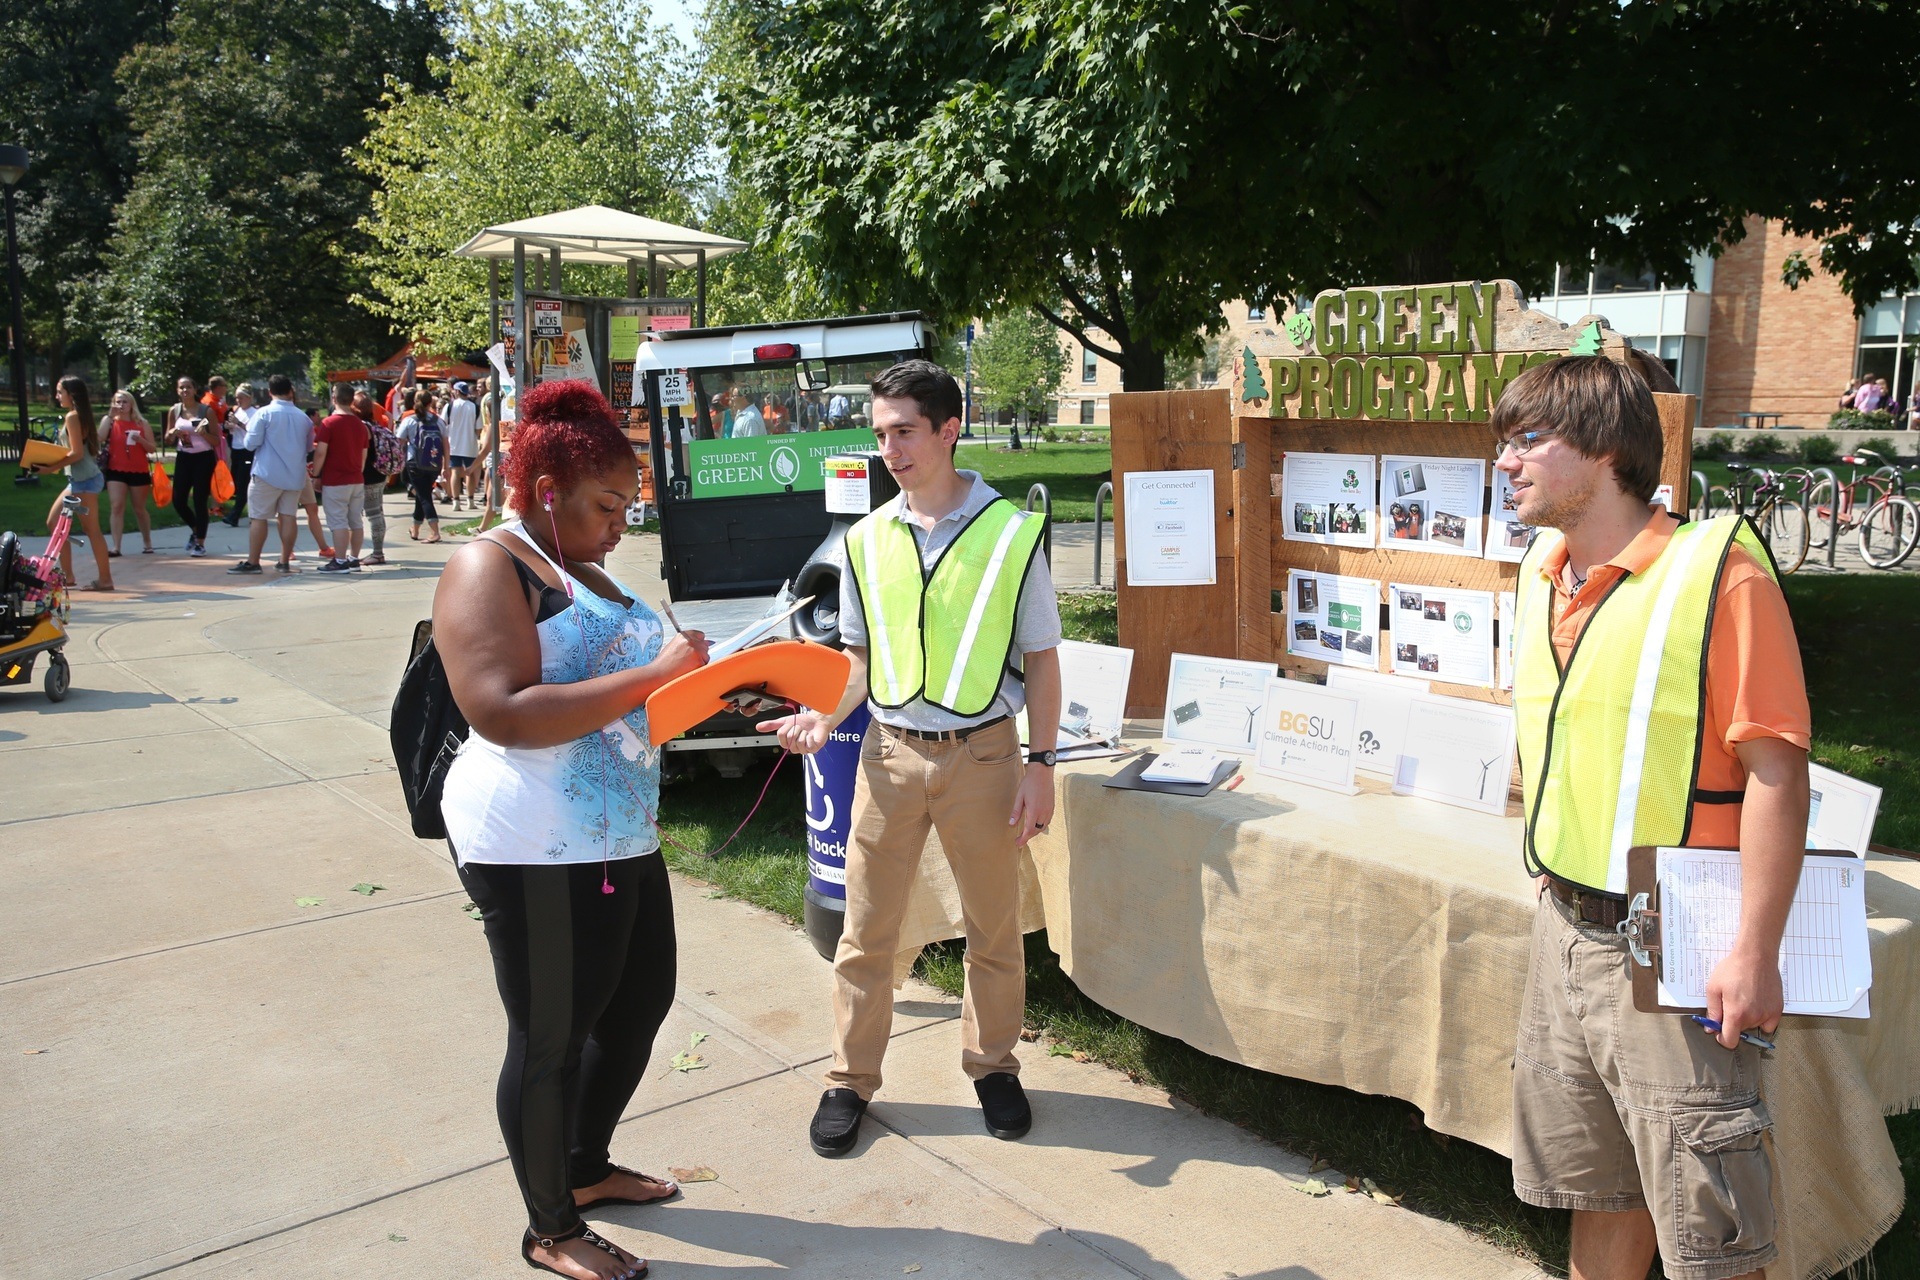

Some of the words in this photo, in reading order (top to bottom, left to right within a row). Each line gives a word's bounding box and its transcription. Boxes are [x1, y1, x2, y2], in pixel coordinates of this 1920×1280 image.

[538, 316, 557, 326] WICKS
[1315, 283, 1500, 355] GREEN
[665, 377, 680, 388] 25
[1268, 353, 1560, 423] PROGRAM
[701, 452, 757, 466] STUDENT
[809, 443, 876, 458] INITIATIVE
[697, 466, 763, 485] GREEN
[829, 730, 860, 742] Here
[1278, 710, 1334, 740] BGSU
[1264, 731, 1298, 746] Climate
[1300, 738, 1328, 752] Action
[1331, 744, 1350, 758] Plan
[814, 834, 846, 858] back
